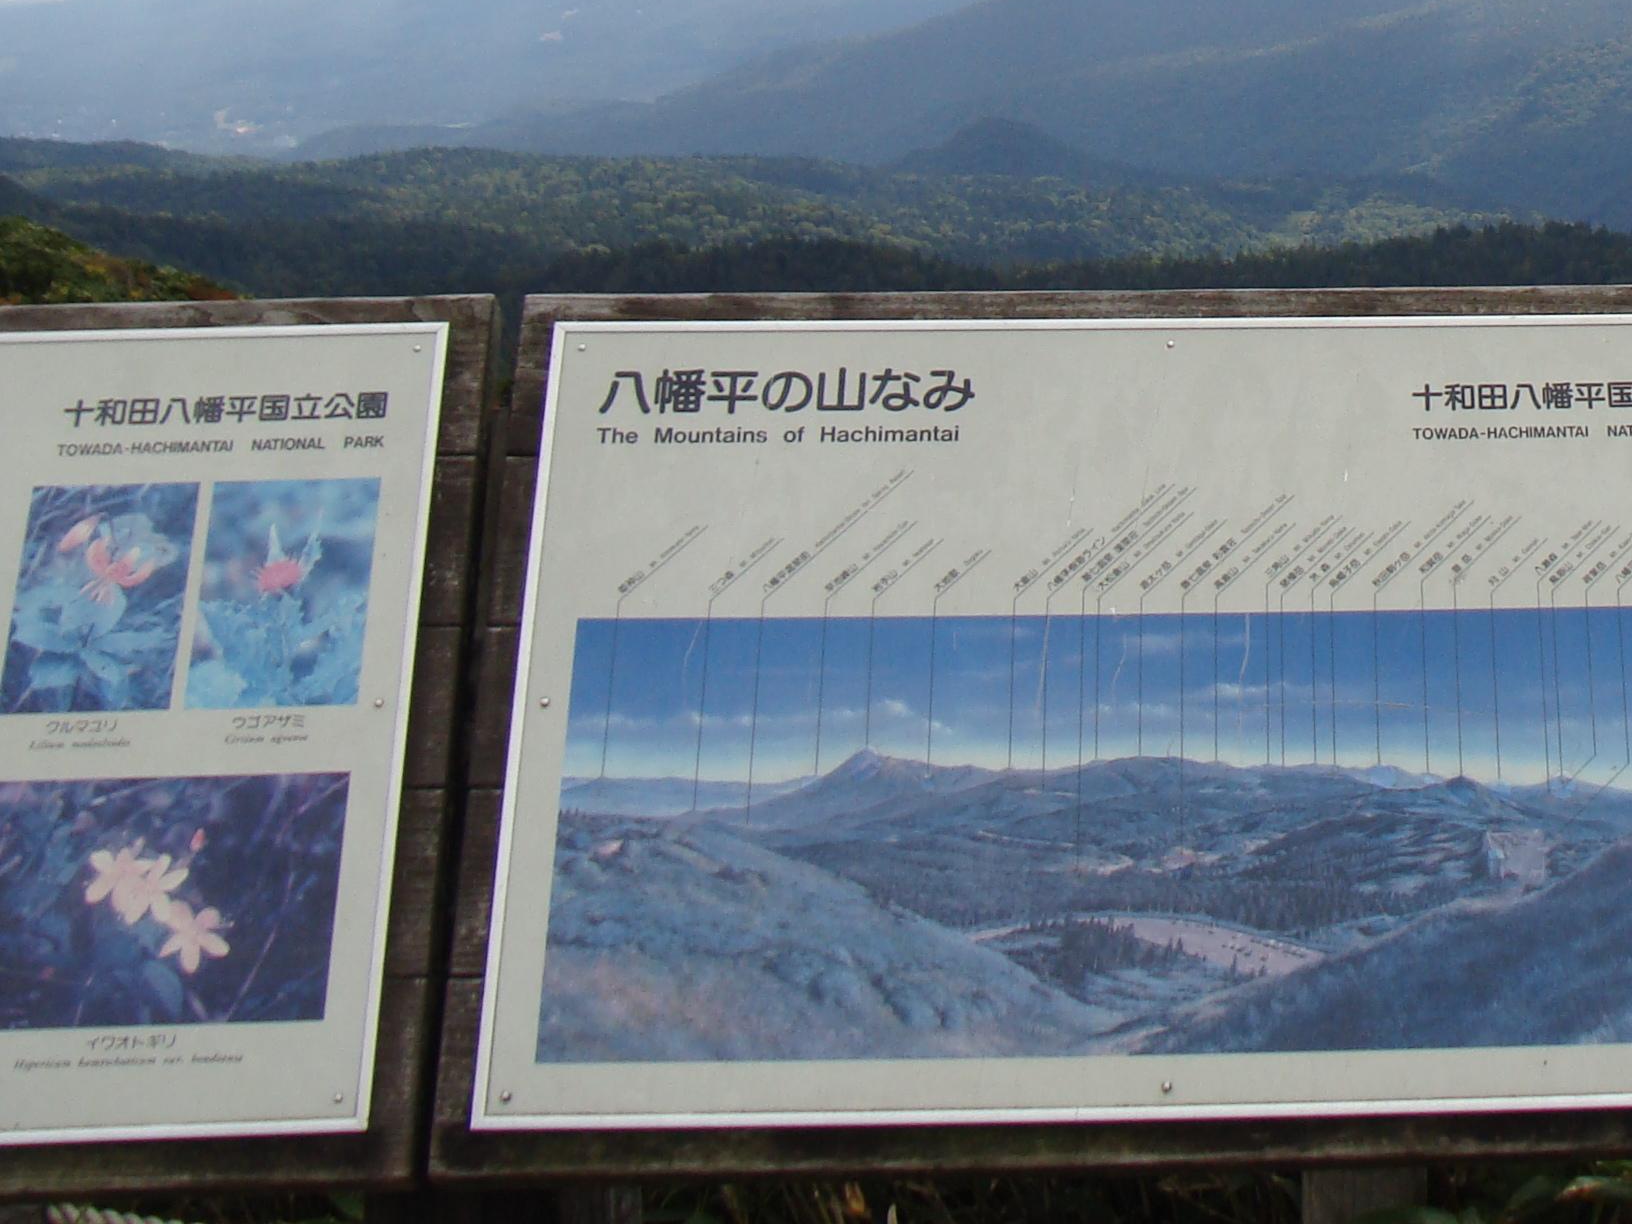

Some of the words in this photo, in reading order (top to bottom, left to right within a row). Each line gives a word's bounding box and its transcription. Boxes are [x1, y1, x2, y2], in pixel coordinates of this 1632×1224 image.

[598, 367, 976, 415] 八幡平の山なみ
[63, 391, 389, 428] 十和田八幡平国立公園
[597, 426, 639, 445] The
[653, 425, 768, 444] Mountains
[783, 424, 806, 444] of
[819, 424, 960, 443] Hachimantai
[1412, 425, 1589, 440] TOWADA-HACHIMANTAI
[57, 439, 234, 458] TOWADA-HACHIMANTAI
[251, 437, 326, 452] NATIONAL
[343, 435, 385, 450] PARK
